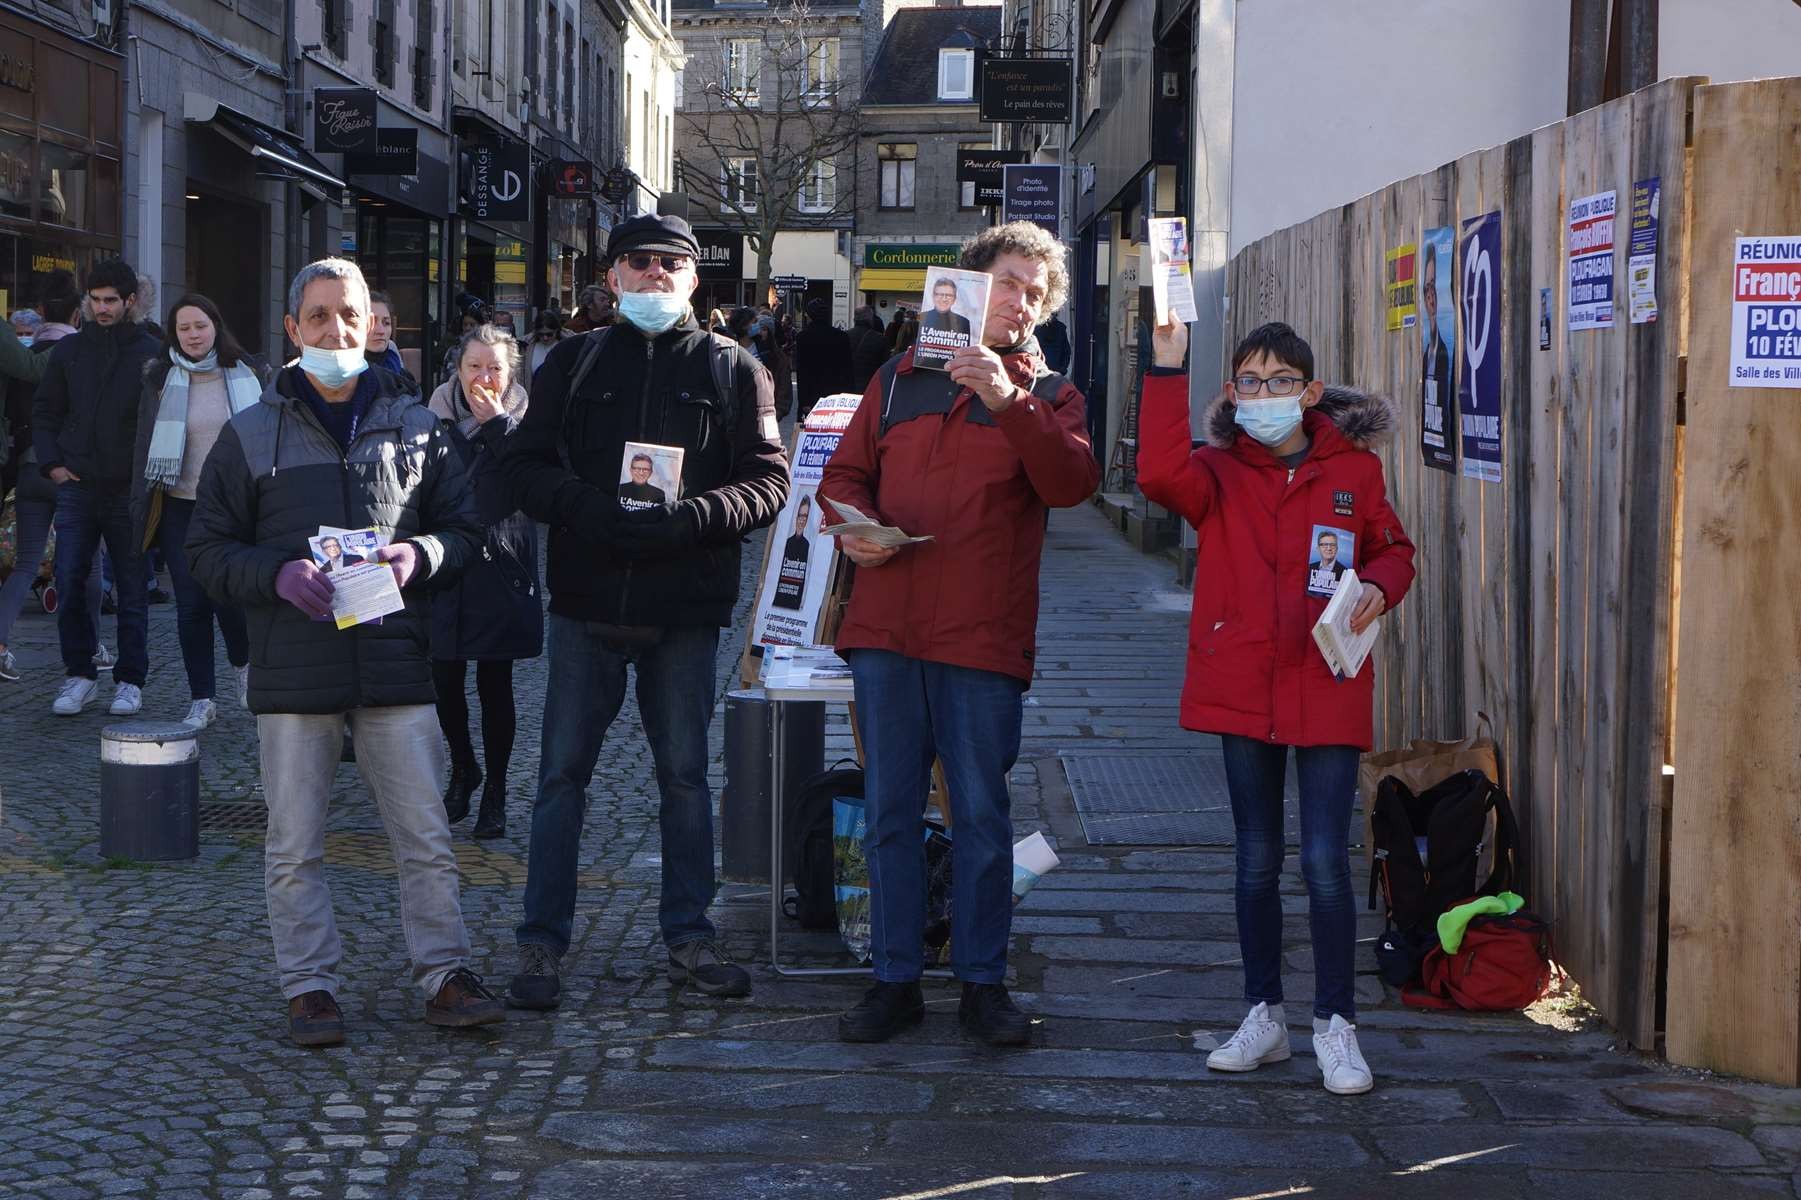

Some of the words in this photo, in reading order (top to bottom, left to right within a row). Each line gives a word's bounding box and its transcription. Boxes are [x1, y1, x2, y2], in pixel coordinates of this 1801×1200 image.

[1004, 100, 1014, 108] Le
[1014, 99, 1030, 110] pain
[1032, 99, 1045, 108] des
[329, 117, 372, 135] Raisin
[478, 146, 488, 217] DESSANGE
[1016, 185, 1048, 193] d'identité
[1011, 199, 1032, 207] Tirage
[1033, 199, 1054, 207] photo
[711, 245, 730, 260] DAN
[873, 249, 956, 264] Cordonnerie
[921, 326, 957, 338] L'Avenir
[957, 332, 969, 340] en
[920, 335, 968, 348] commun
[1749, 336, 1770, 356] 10
[1736, 366, 1760, 378] Salle
[1763, 367, 1781, 379] des
[1784, 367, 1801, 379] Vill
[620, 496, 654, 508] L'Avenir
[1336, 493, 1353, 503] IKKS
